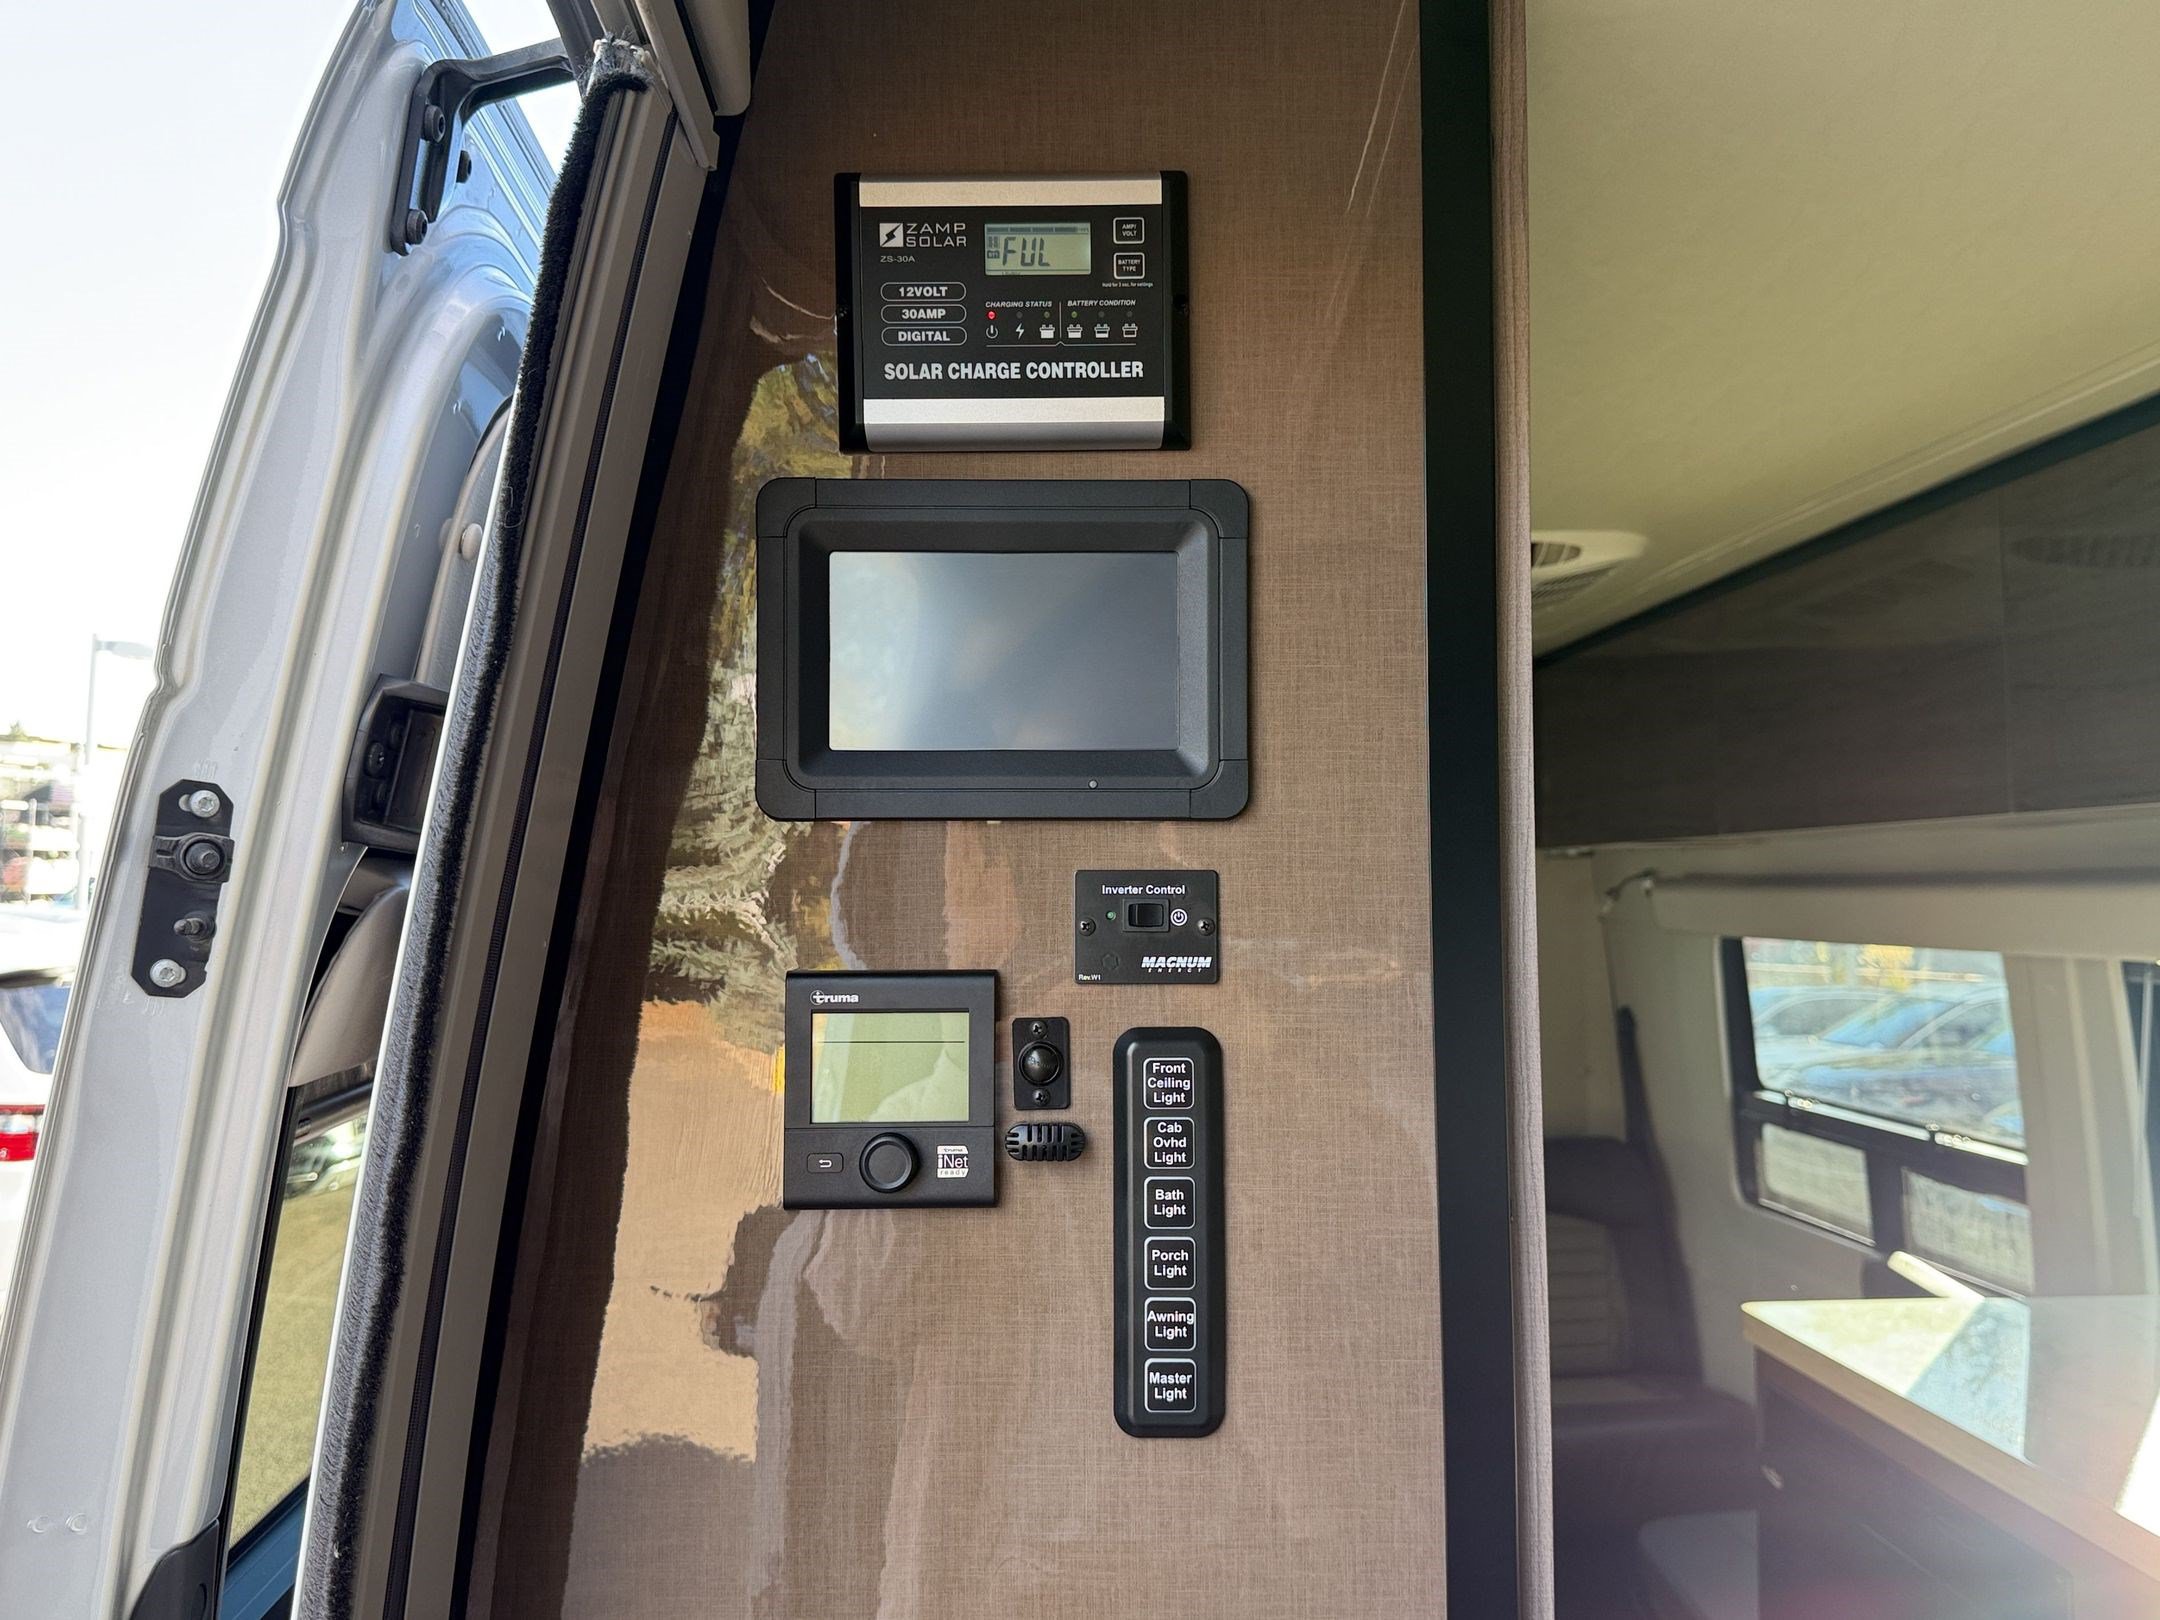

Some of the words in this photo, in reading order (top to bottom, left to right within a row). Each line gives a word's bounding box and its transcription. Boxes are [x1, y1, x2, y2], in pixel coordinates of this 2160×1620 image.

[906, 223, 966, 234] ZAMP
[906, 236, 967, 247] SOLAR
[1002, 236, 1051, 267] FUL
[880, 255, 916, 263] ZS-30A
[899, 286, 948, 297] 12VOLT
[901, 308, 946, 319] 30AMP
[898, 331, 950, 342] DIGITAL
[884, 363, 943, 380] SOLAR
[948, 362, 1021, 380] CHARGE
[1026, 361, 1144, 379] CONTROLLER
[1102, 885, 1143, 895] Inverter
[1146, 885, 1185, 895] Control
[1142, 956, 1212, 968] MAGNUM
[811, 990, 859, 1005] truma
[1152, 1062, 1186, 1074] Front
[1147, 1077, 1191, 1090] Ceiling
[1153, 1092, 1186, 1105] Light
[1157, 1122, 1182, 1133] Cab
[1153, 1136, 1187, 1148] Ovhd
[938, 1154, 969, 1168] iNet
[1154, 1151, 1187, 1165] Light
[1155, 1189, 1184, 1200] Bath
[1154, 1204, 1186, 1218] Light
[1152, 1250, 1188, 1262] Porch
[1154, 1265, 1187, 1279] Light
[1147, 1310, 1194, 1325] Awning
[1155, 1326, 1187, 1340] Light
[1149, 1372, 1192, 1384] Master
[1154, 1387, 1187, 1402] Light
